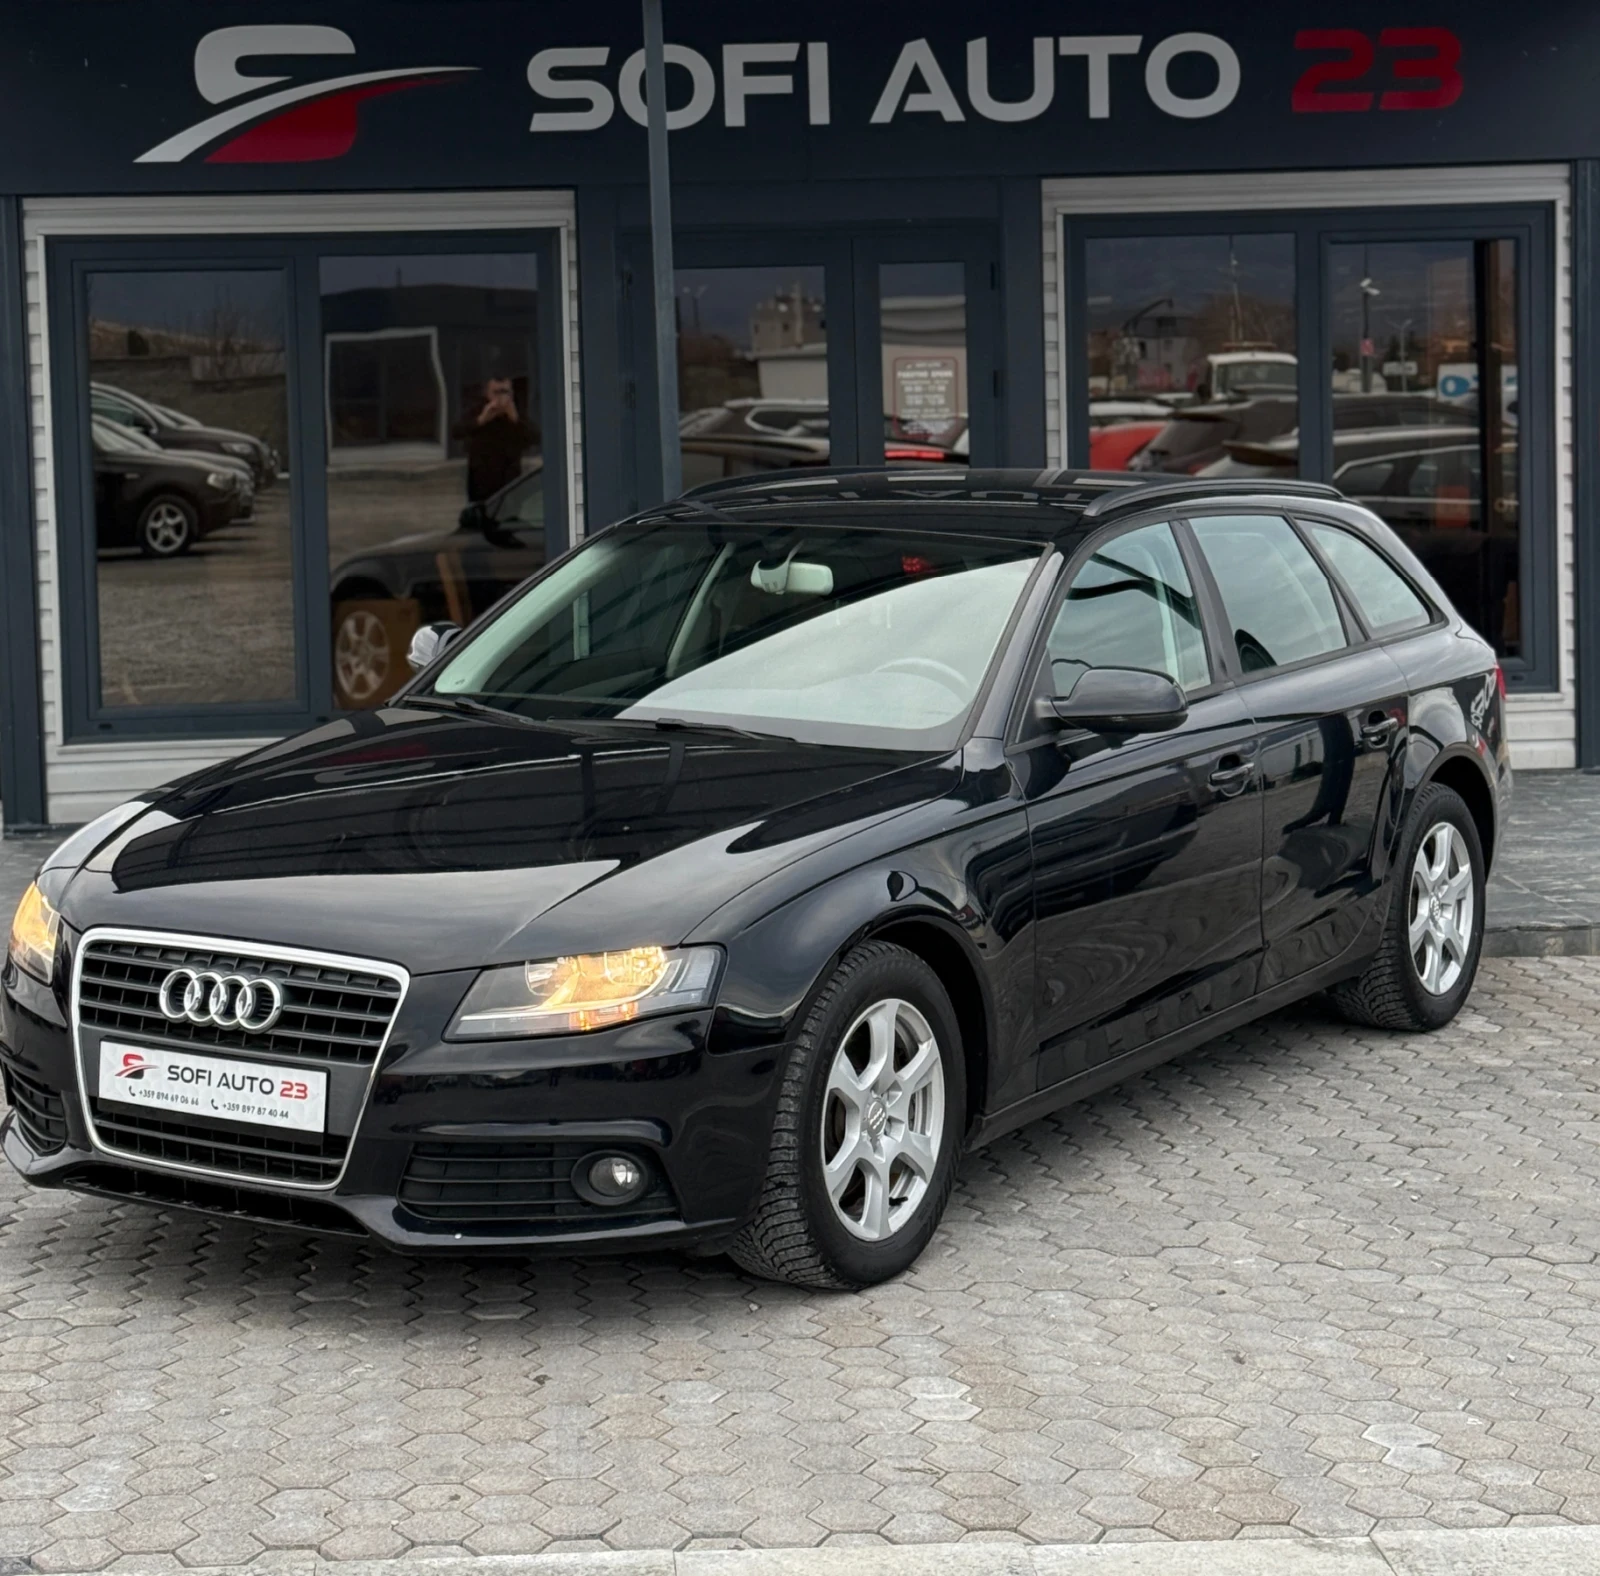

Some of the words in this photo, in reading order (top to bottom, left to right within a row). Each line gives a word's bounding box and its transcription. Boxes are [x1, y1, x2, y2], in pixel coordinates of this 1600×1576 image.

[527, 42, 830, 132] SOFI
[869, 32, 1241, 124] AUTO
[1292, 28, 1464, 112] 23
[139, 1088, 155, 1100] +359
[156, 1091, 169, 1102] 894
[170, 1094, 179, 1103] 69
[167, 1064, 212, 1087] SOFI
[216, 1072, 275, 1096] AUTO
[279, 1080, 308, 1100] 23
[222, 1102, 240, 1112] +359
[241, 1104, 256, 1115] 897
[256, 1106, 267, 1116] 87
[267, 1109, 278, 1118] 40
[279, 1110, 289, 1120] 44
